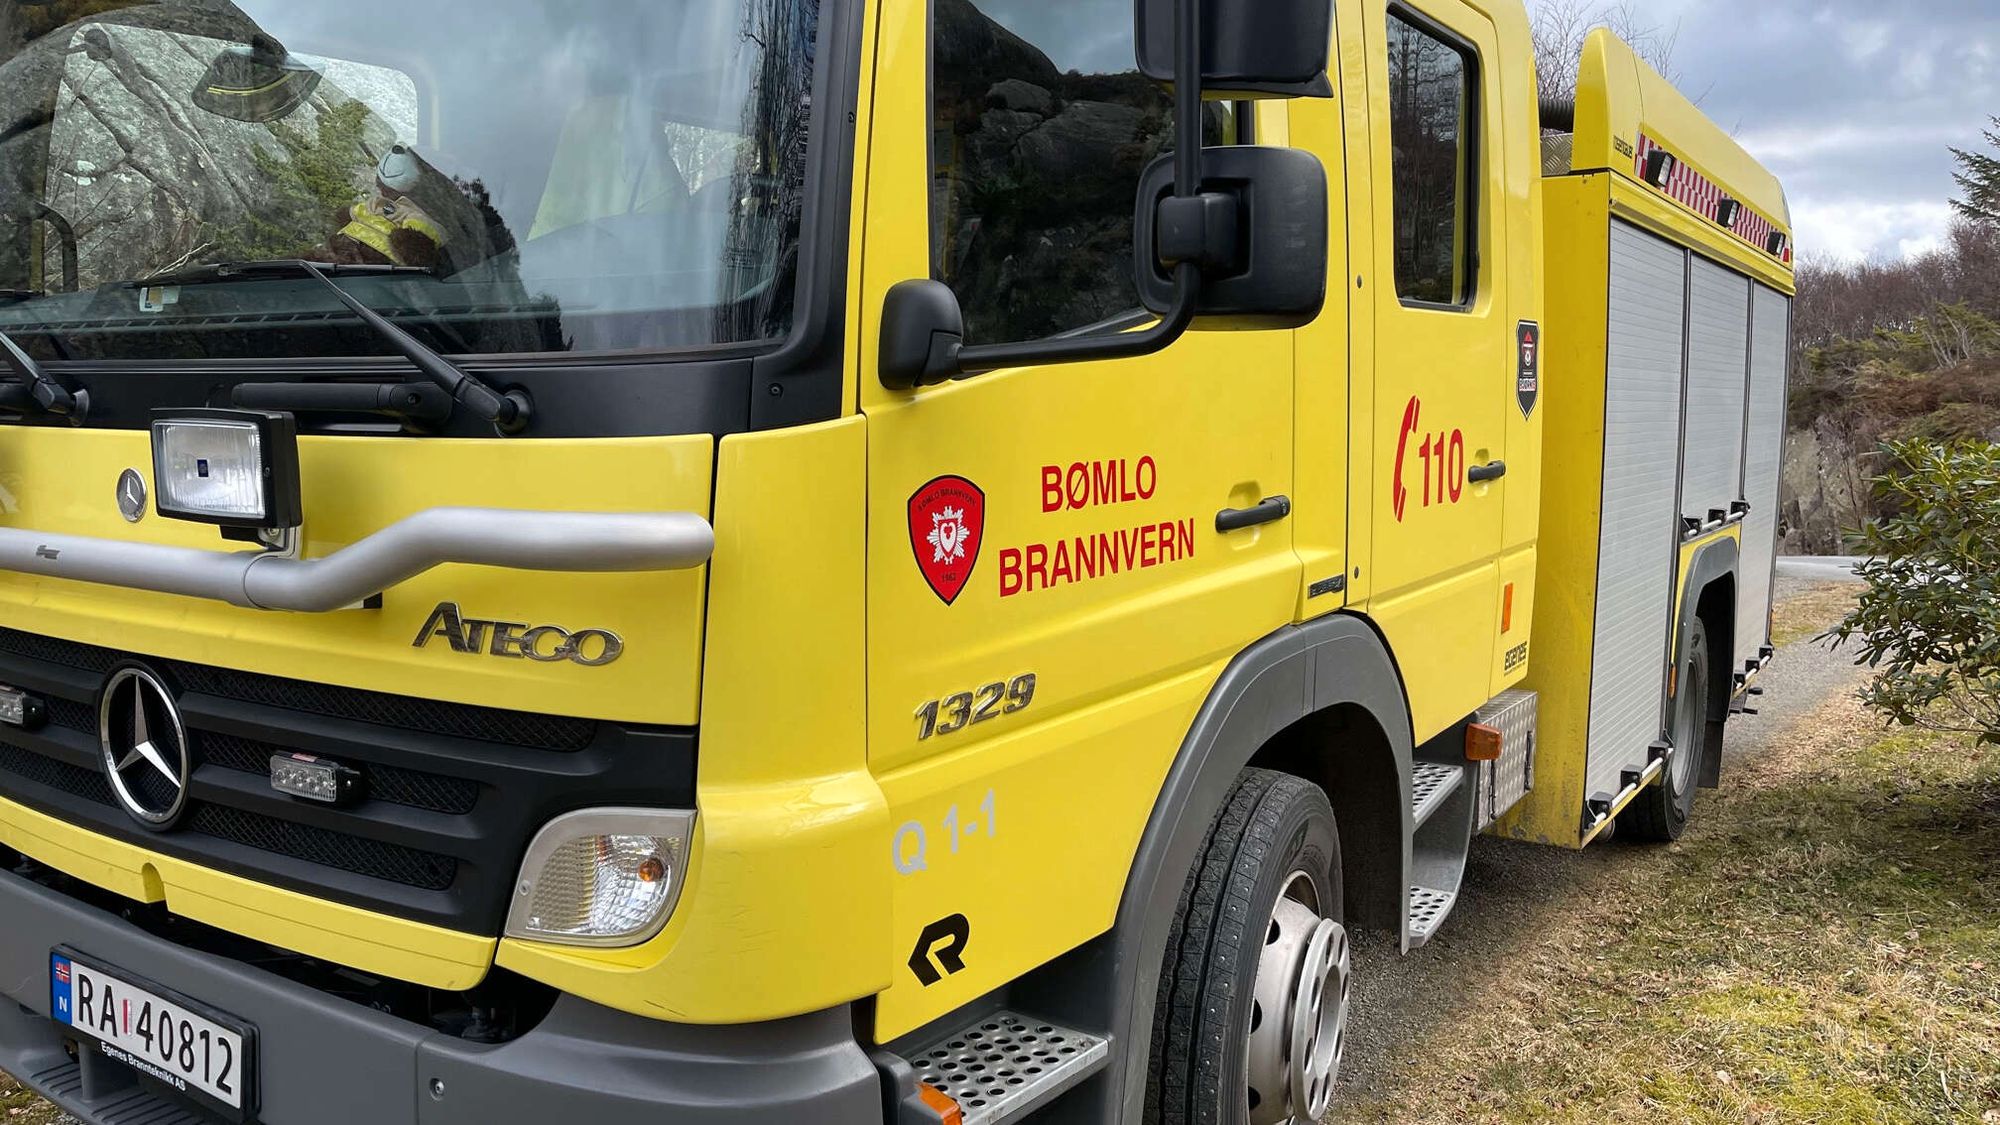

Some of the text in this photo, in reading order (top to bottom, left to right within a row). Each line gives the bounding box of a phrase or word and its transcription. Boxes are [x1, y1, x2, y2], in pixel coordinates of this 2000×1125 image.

[1041, 455, 1157, 513] BØMLO
[1418, 428, 1464, 508] 110
[999, 517, 1195, 598] BRANNVERN
[914, 672, 1037, 741] 1329
[892, 788, 997, 876] Q 1-1
[58, 995, 68, 1013] N
[100, 1041, 187, 1092] Egenes Brannteknikk AS
[135, 1000, 233, 1096] 40812
